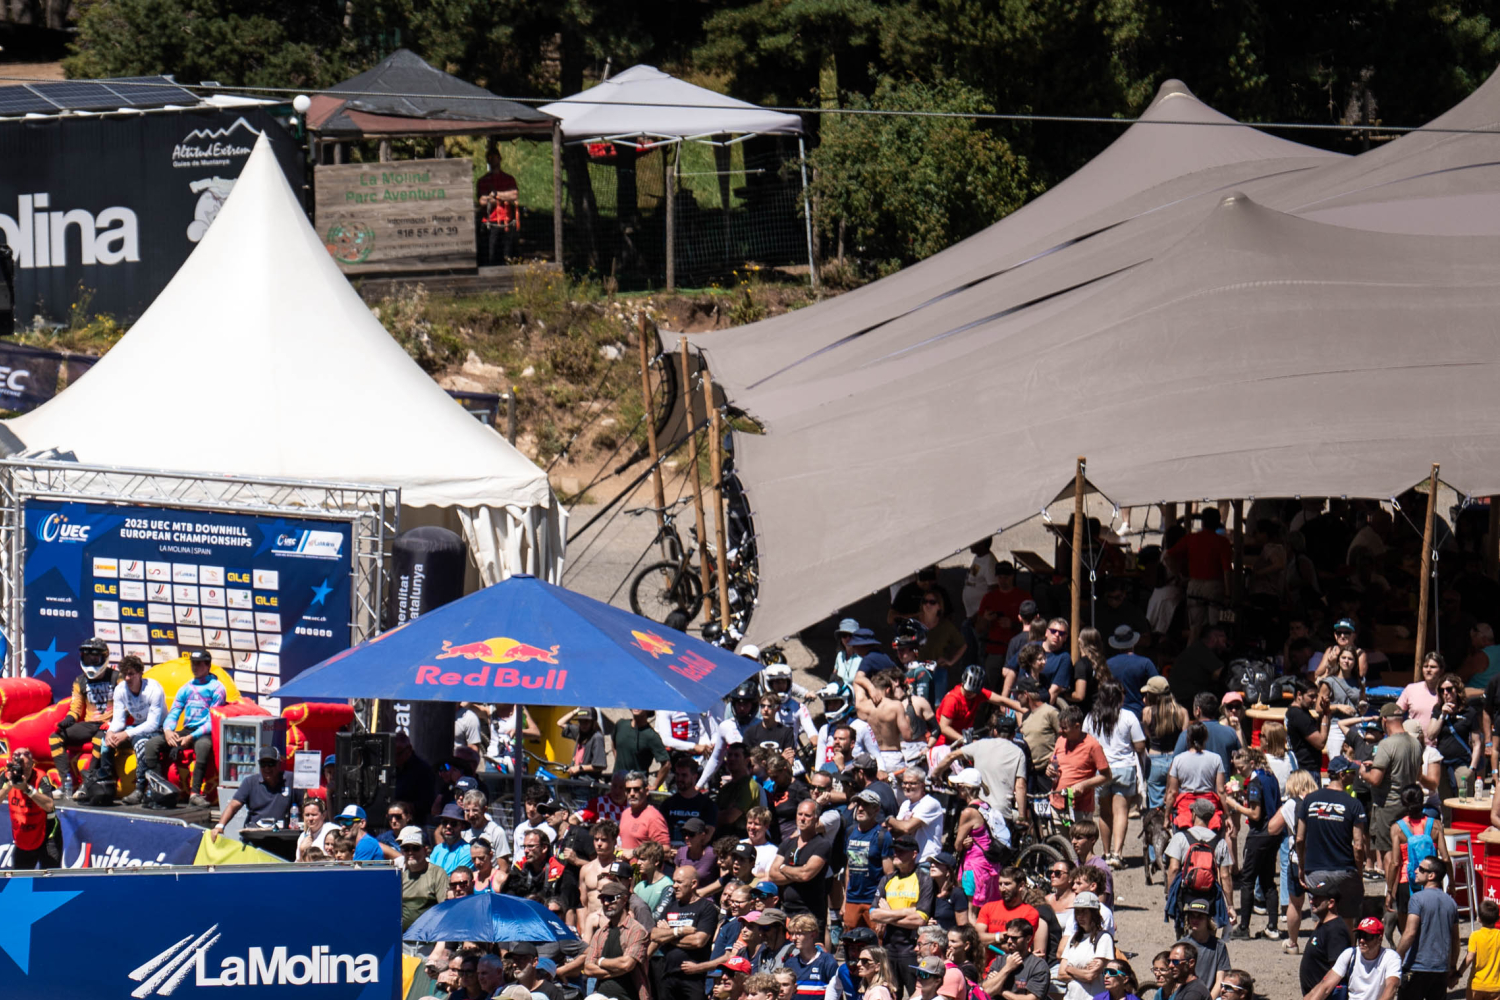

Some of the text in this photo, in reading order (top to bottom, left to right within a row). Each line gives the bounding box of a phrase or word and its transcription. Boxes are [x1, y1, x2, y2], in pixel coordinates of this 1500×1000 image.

[360, 172, 430, 186] La Molina
[346, 188, 446, 203] Parc Aventura
[60, 524, 91, 538] UEC
[124, 518, 248, 537] 2025 UEC MTB DOWNHILL
[120, 528, 252, 547] EUROPEAN CHAMPIONSHIPS
[194, 548, 212, 556] SPAIN
[415, 666, 568, 690] Red Bull
[196, 945, 379, 986] LaMolina
